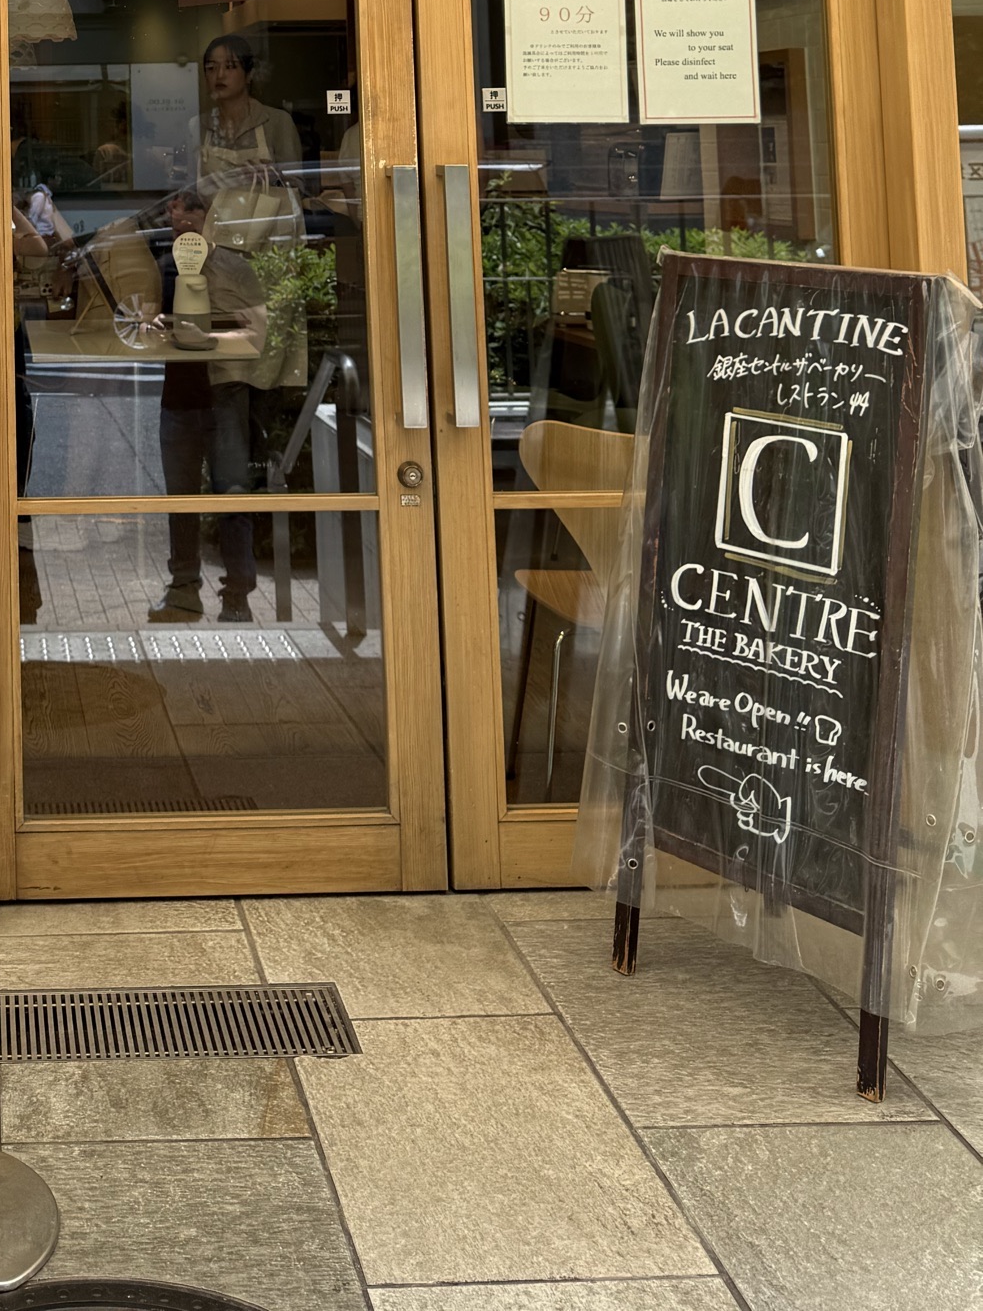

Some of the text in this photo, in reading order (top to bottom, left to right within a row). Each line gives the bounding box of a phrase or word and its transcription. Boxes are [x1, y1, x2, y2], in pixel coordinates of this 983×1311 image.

[654, 29, 725, 39] We will show you
[698, 45, 716, 53] your
[654, 57, 716, 66] Please disinfect
[684, 71, 737, 80] and wait here
[334, 93, 342, 101] 押
[490, 90, 498, 99] 押
[738, 434, 818, 549] C
[670, 562, 881, 659] CENTRE
[680, 618, 842, 685] THE BAKERY
[666, 669, 697, 705] We
[698, 690, 731, 712] are
[681, 713, 800, 770] Restaurant
[805, 757, 822, 775] is
